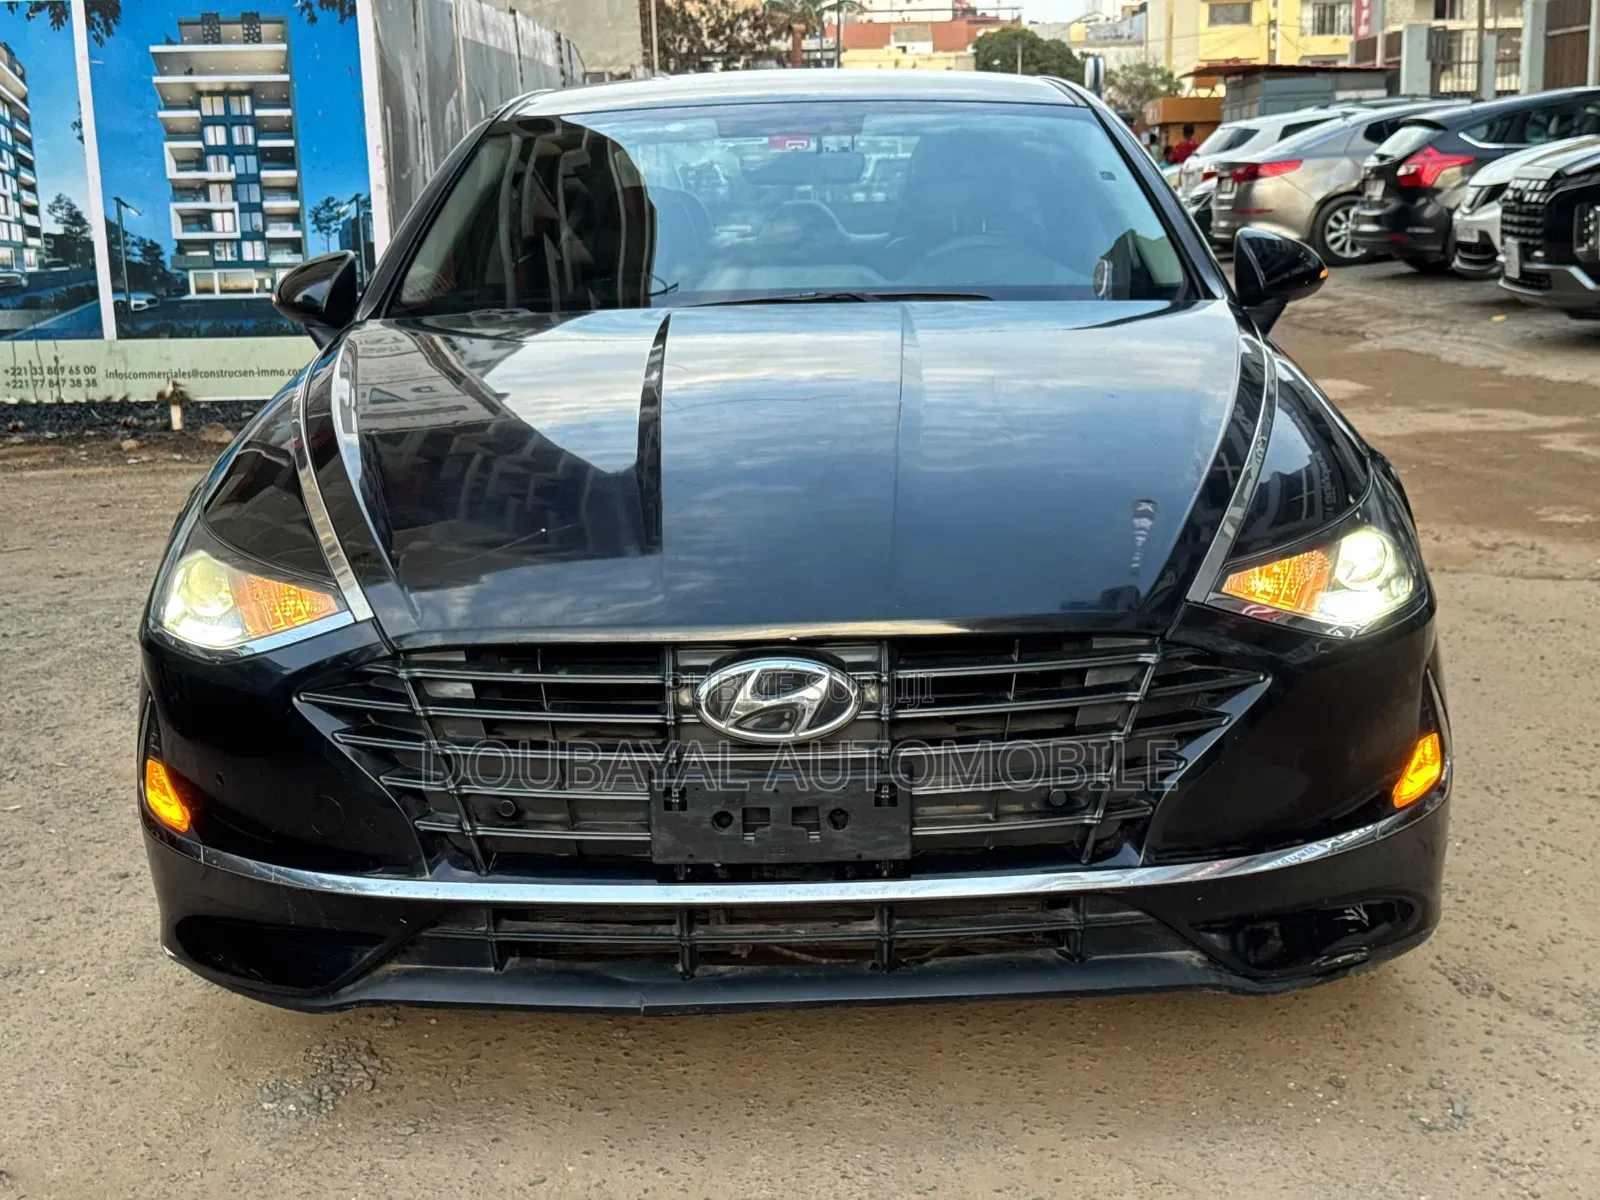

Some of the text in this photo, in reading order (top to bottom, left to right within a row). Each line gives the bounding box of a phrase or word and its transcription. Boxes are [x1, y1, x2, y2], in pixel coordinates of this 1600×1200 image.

[3, 365, 28, 377] +221
[68, 365, 82, 376] 65
[83, 364, 97, 376] 00
[5, 379, 29, 390] +221
[32, 378, 46, 389] 77
[68, 378, 83, 389] 38
[84, 378, 98, 389] 38
